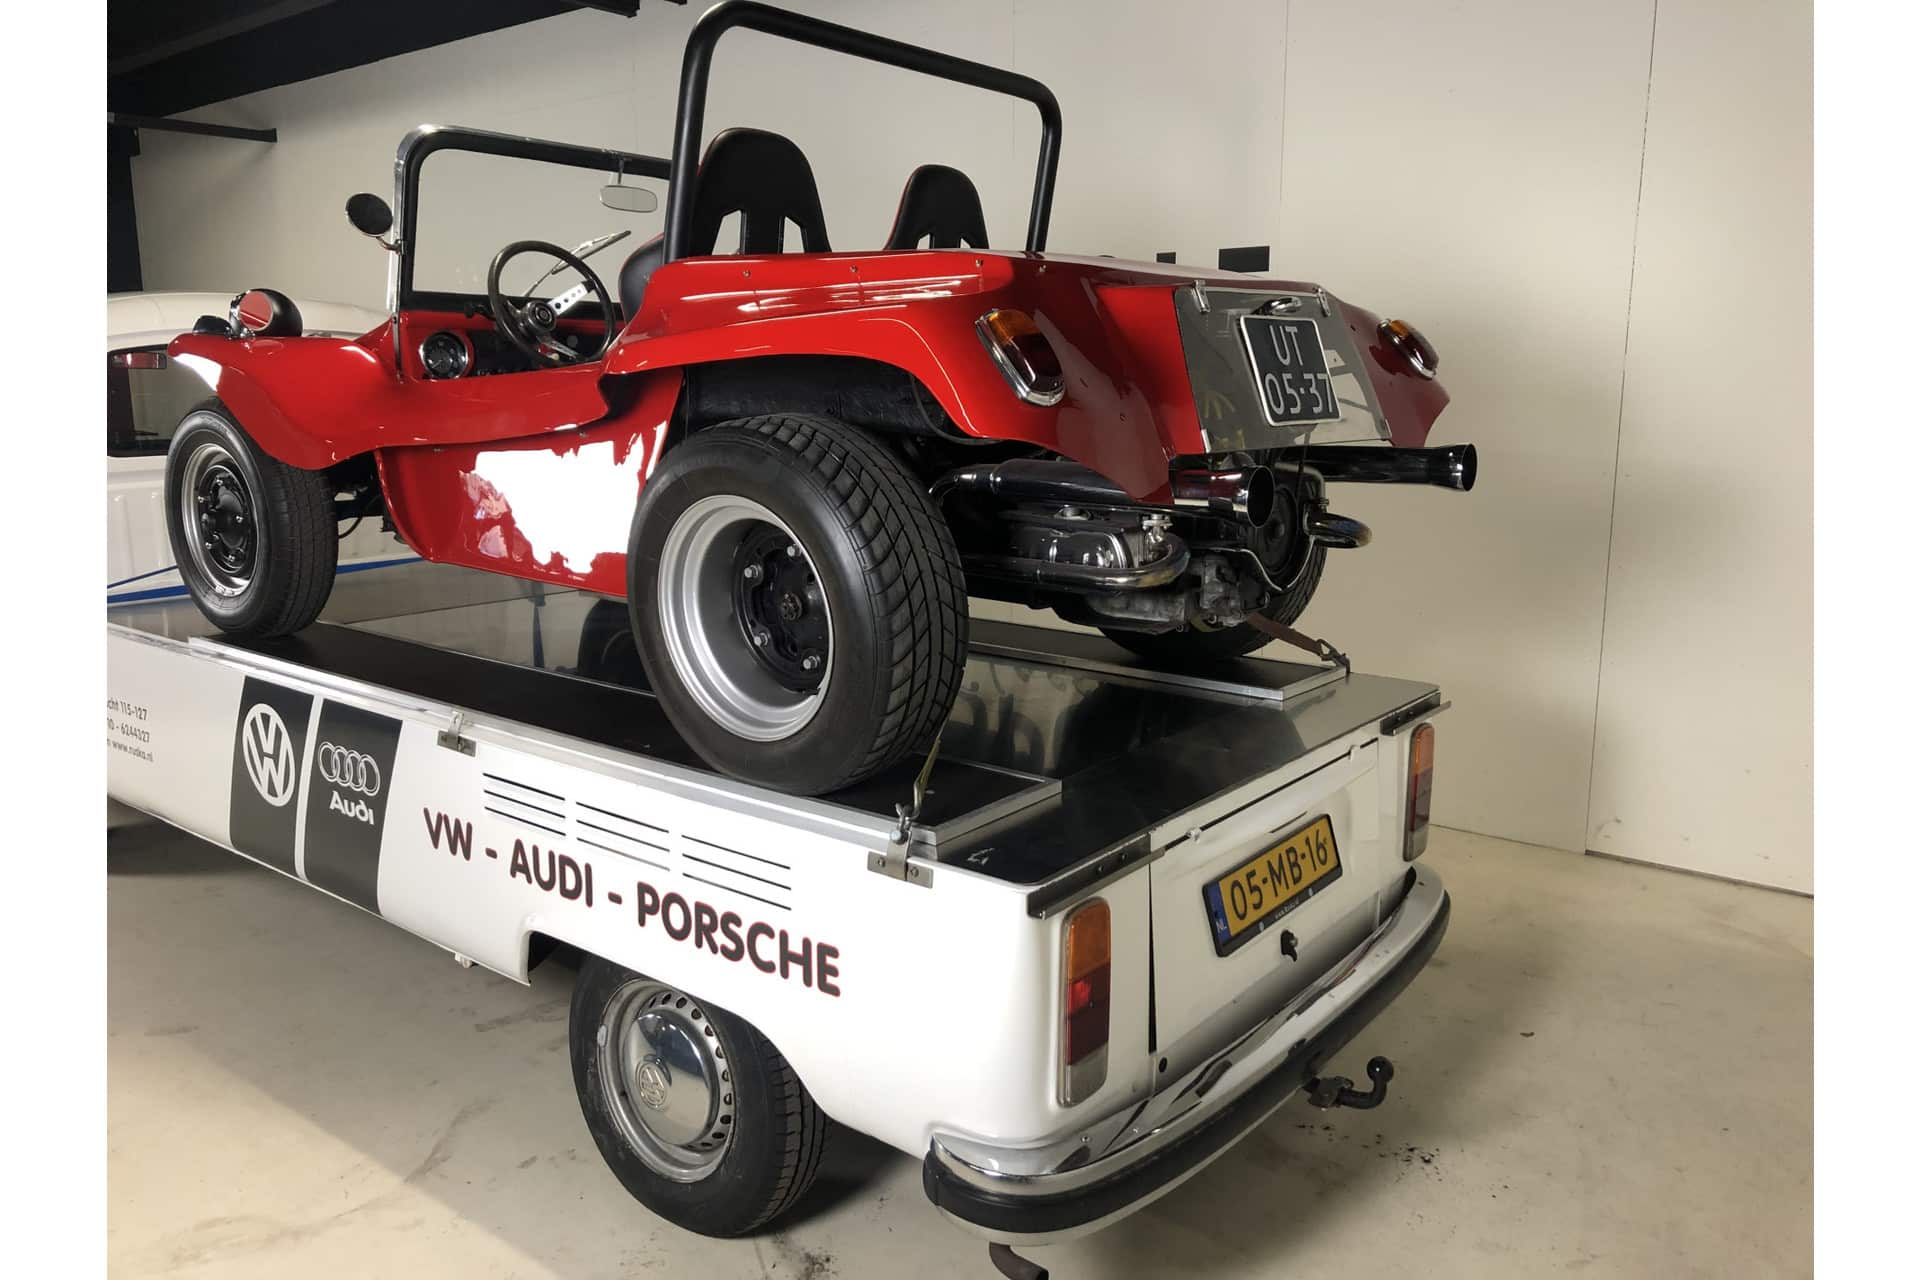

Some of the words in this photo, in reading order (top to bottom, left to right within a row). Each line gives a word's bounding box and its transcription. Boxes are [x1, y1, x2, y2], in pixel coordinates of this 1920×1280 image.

[1268, 325, 1304, 366] UT
[1264, 373, 1334, 415] 05-37
[120, 700, 148, 721] 115-127
[329, 790, 375, 825] Audi
[1230, 829, 1329, 921] 05-MB-16
[423, 807, 473, 861] VW
[509, 838, 594, 908] AUDI
[636, 880, 842, 998] PORSCHE
